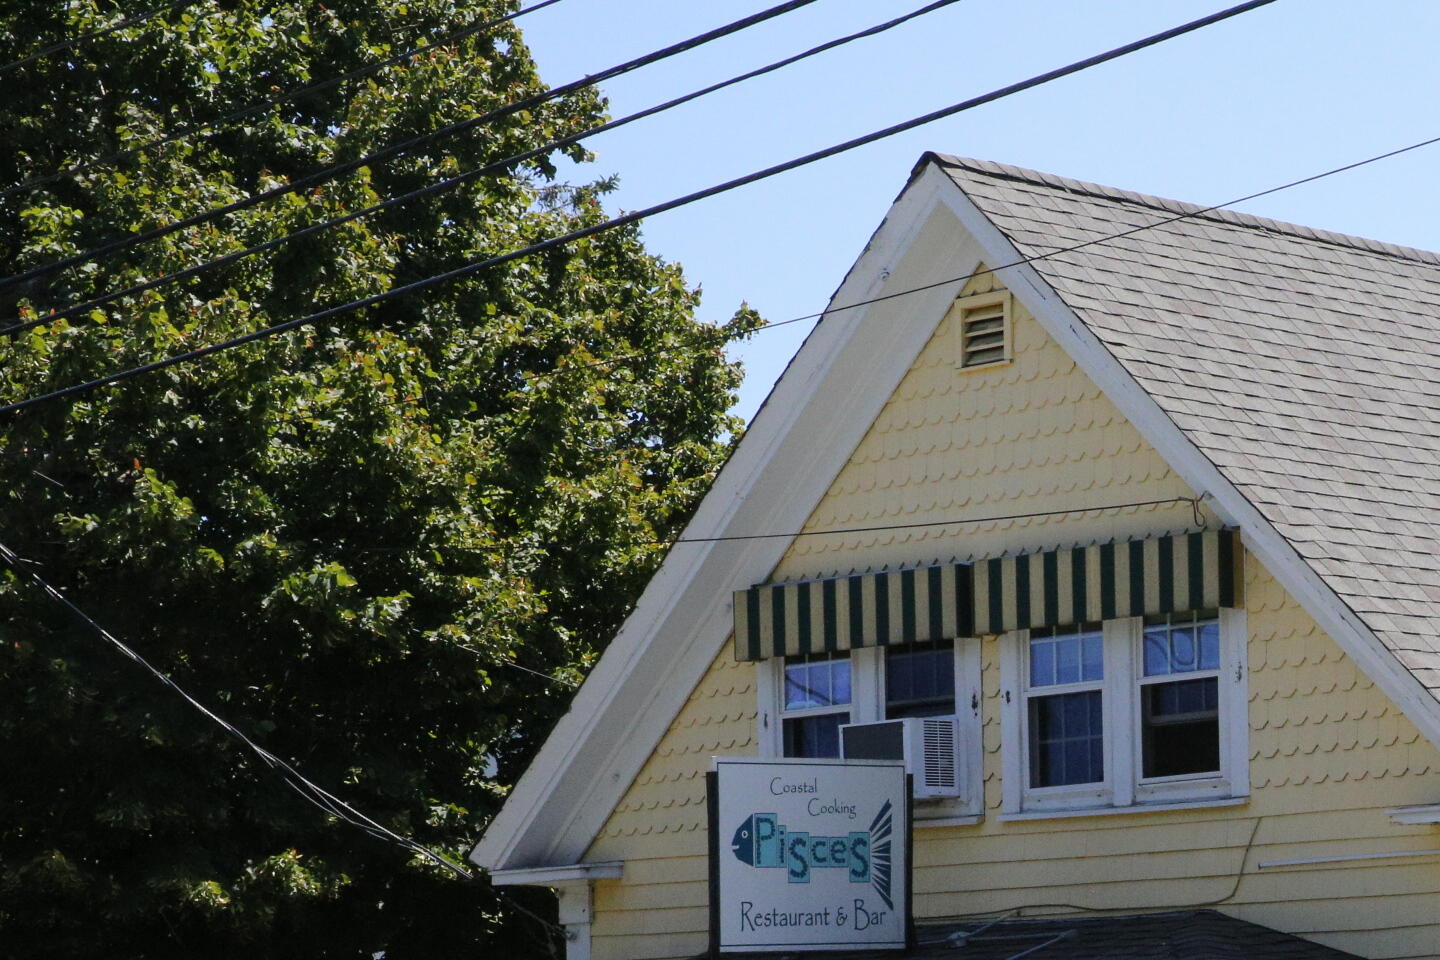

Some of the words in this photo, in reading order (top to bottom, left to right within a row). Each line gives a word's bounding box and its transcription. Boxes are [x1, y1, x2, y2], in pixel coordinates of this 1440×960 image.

[770, 776, 818, 796] Coastal
[807, 798, 857, 819] Cooking
[741, 901, 830, 932] Restaurant
[836, 906, 848, 927] &
[854, 899, 887, 931] Bar
